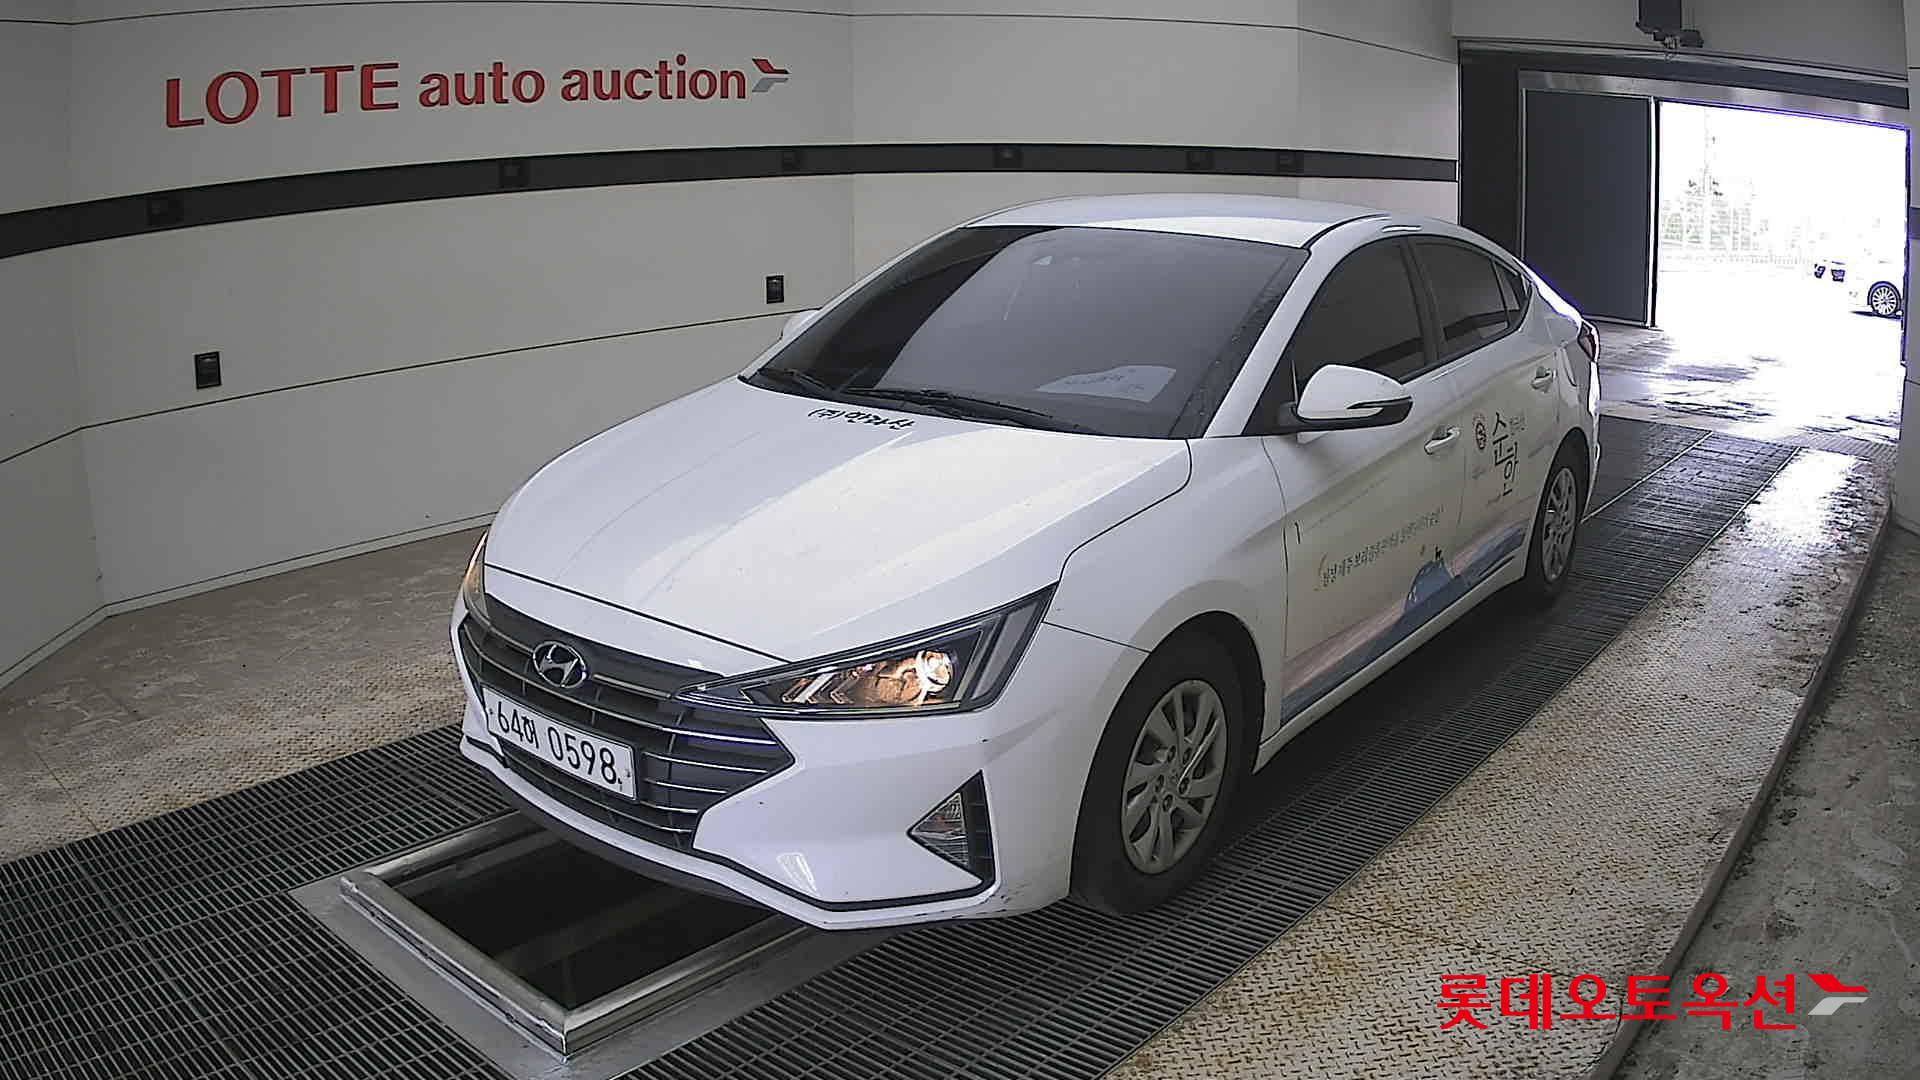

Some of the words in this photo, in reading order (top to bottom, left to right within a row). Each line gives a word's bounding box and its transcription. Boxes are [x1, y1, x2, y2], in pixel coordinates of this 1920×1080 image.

[165, 62, 400, 128] LOTTE
[418, 61, 546, 107] auto
[560, 53, 747, 101] auction
[547, 726, 618, 785] 0598
